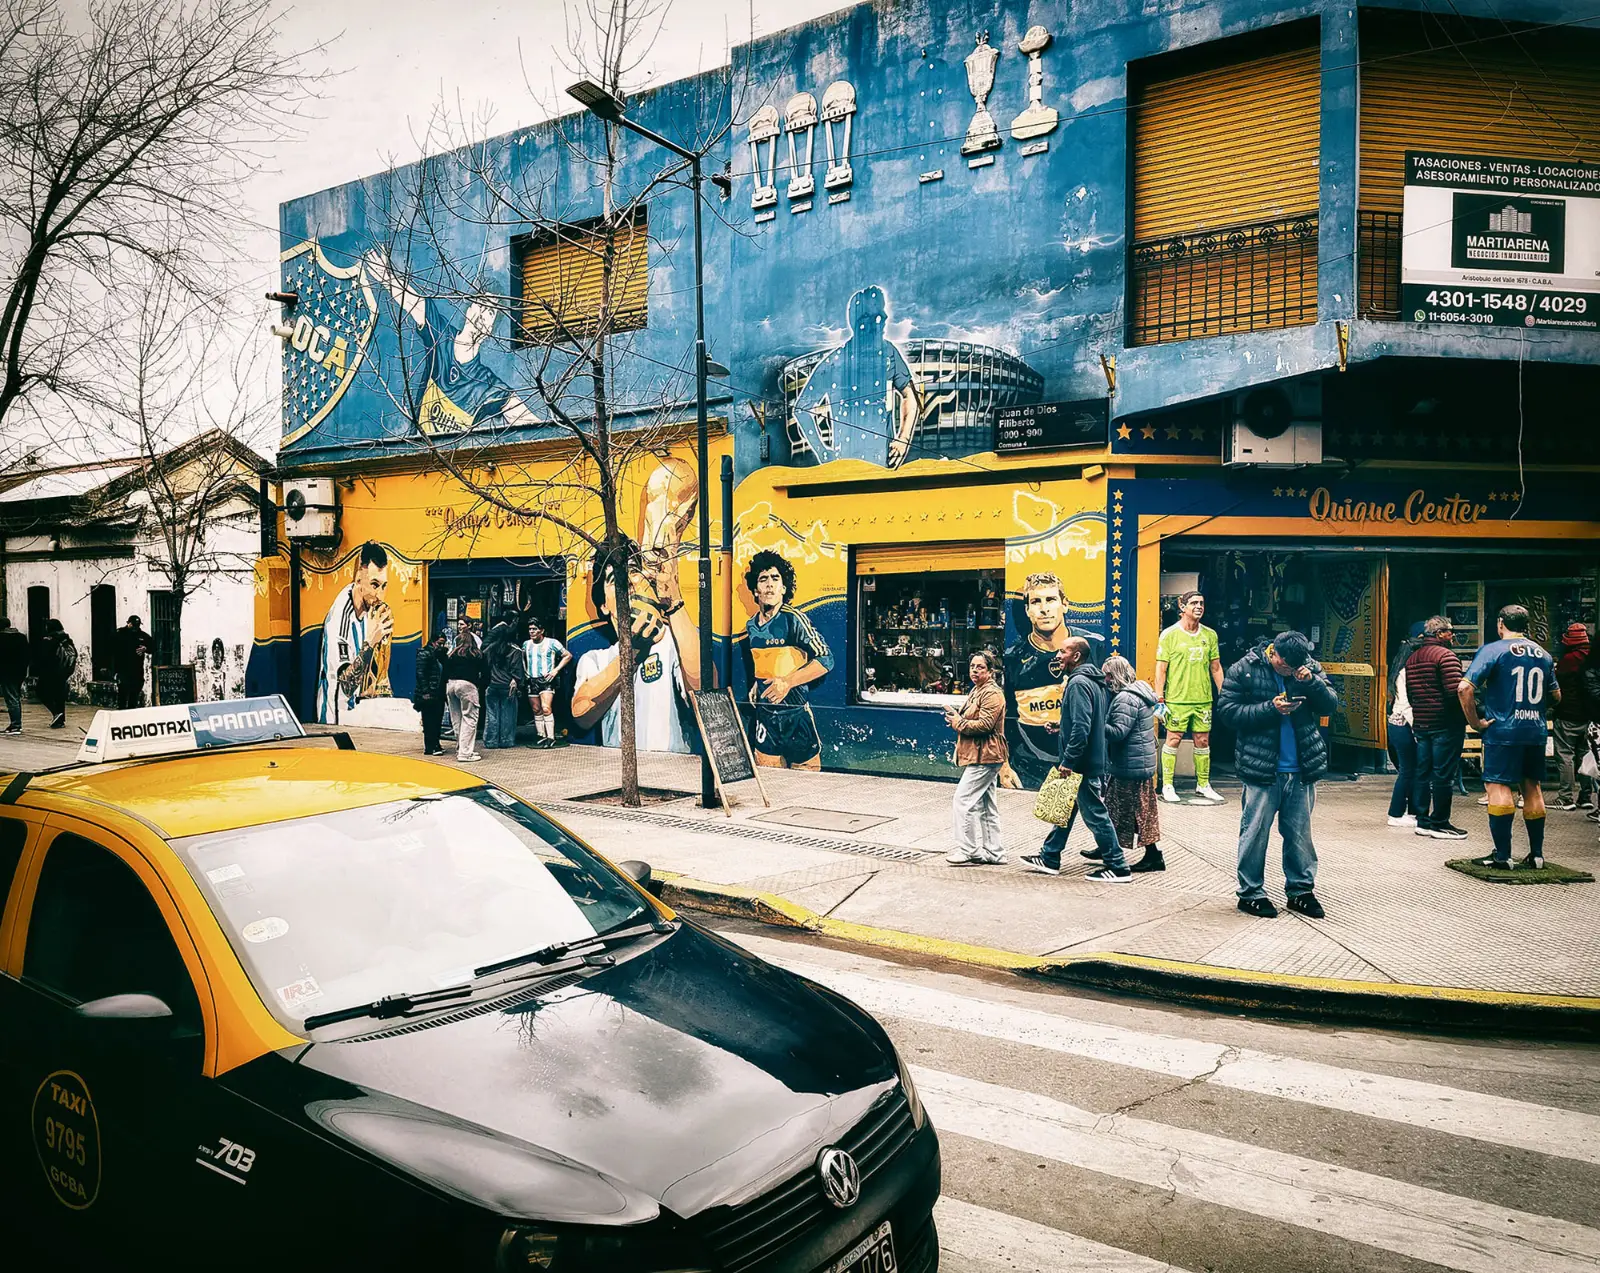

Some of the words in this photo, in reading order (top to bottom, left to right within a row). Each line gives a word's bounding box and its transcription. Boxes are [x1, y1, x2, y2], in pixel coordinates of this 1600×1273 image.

[1413, 157, 1481, 171] TASACIONES
[1489, 163, 1531, 175] VENTAS
[1416, 170, 1509, 185] ASESORAMIENTO
[1467, 235, 1550, 251] MARTIARENA
[1469, 250, 1499, 259] NEGOCIOS
[1501, 251, 1548, 261] INMOBILIARIOS
[1426, 290, 1527, 310] 4301-1548
[1529, 294, 1537, 312] /
[1539, 296, 1587, 313] 4029
[1428, 312, 1494, 324] 11-6054-3010
[1000, 408, 1021, 418] Juan
[1023, 407, 1034, 416] de
[1037, 405, 1057, 415] Dios
[998, 418, 1035, 428] Filiberto
[999, 430, 1019, 440] 1000
[1026, 428, 1043, 438] 900
[1309, 487, 1397, 533] Quique
[1403, 489, 1488, 525] Center
[1363, 614, 1371, 664] HISTORI
[1527, 646, 1544, 658] LG
[1511, 665, 1544, 705] 10
[1029, 698, 1063, 713] MEGA
[1514, 709, 1540, 720] ROMAN
[111, 719, 191, 741] RADIOTAXI
[208, 708, 288, 733] PAMPA
[51, 1082, 86, 1117] TAXI
[46, 1116, 86, 1167] 9795
[214, 1137, 256, 1173] 703
[50, 1165, 87, 1200] GCBA
